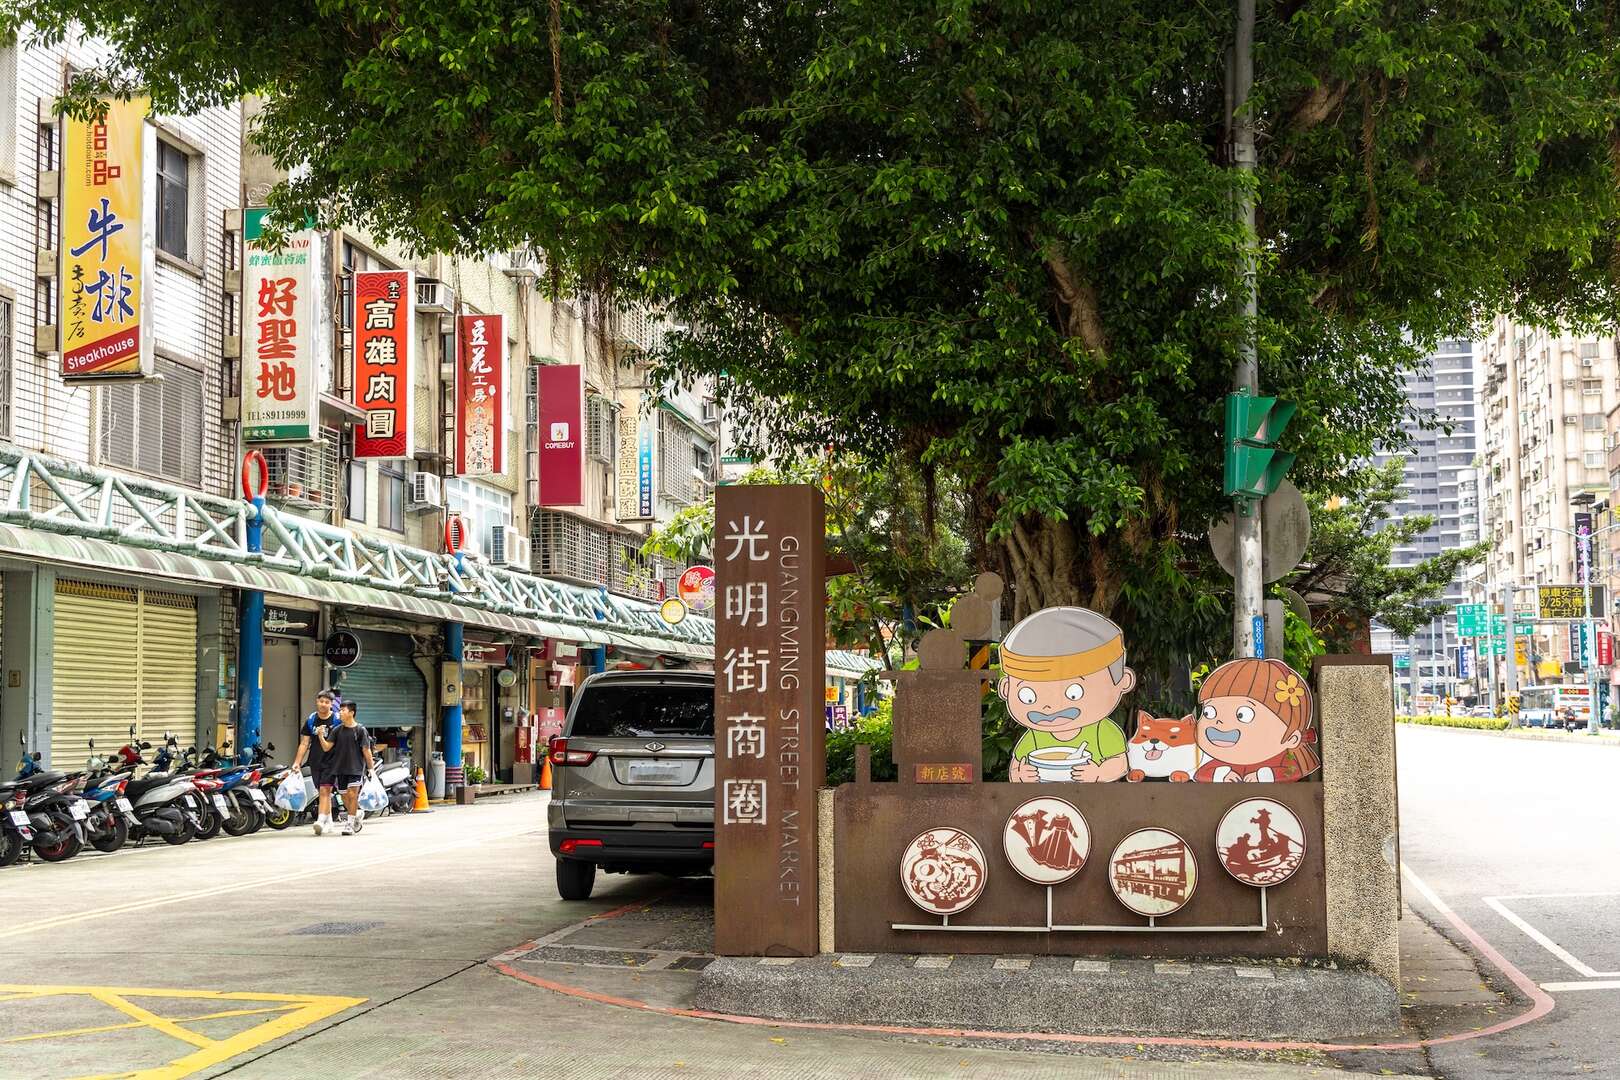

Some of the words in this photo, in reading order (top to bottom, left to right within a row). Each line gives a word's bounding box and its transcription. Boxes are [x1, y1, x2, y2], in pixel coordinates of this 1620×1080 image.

[71, 199, 134, 323] 牛排
[388, 281, 400, 299] 手工
[68, 337, 135, 370] Steakhouse
[257, 277, 297, 401] 好聖地
[365, 299, 397, 439] 高雄肉圓
[469, 319, 493, 402] 豆花工房
[247, 410, 306, 421] TEL:89119999
[779, 536, 799, 689] GUANGMING
[723, 515, 770, 825] 光明街商圈
[780, 709, 799, 791] STREET
[779, 809, 800, 907] MARKET
